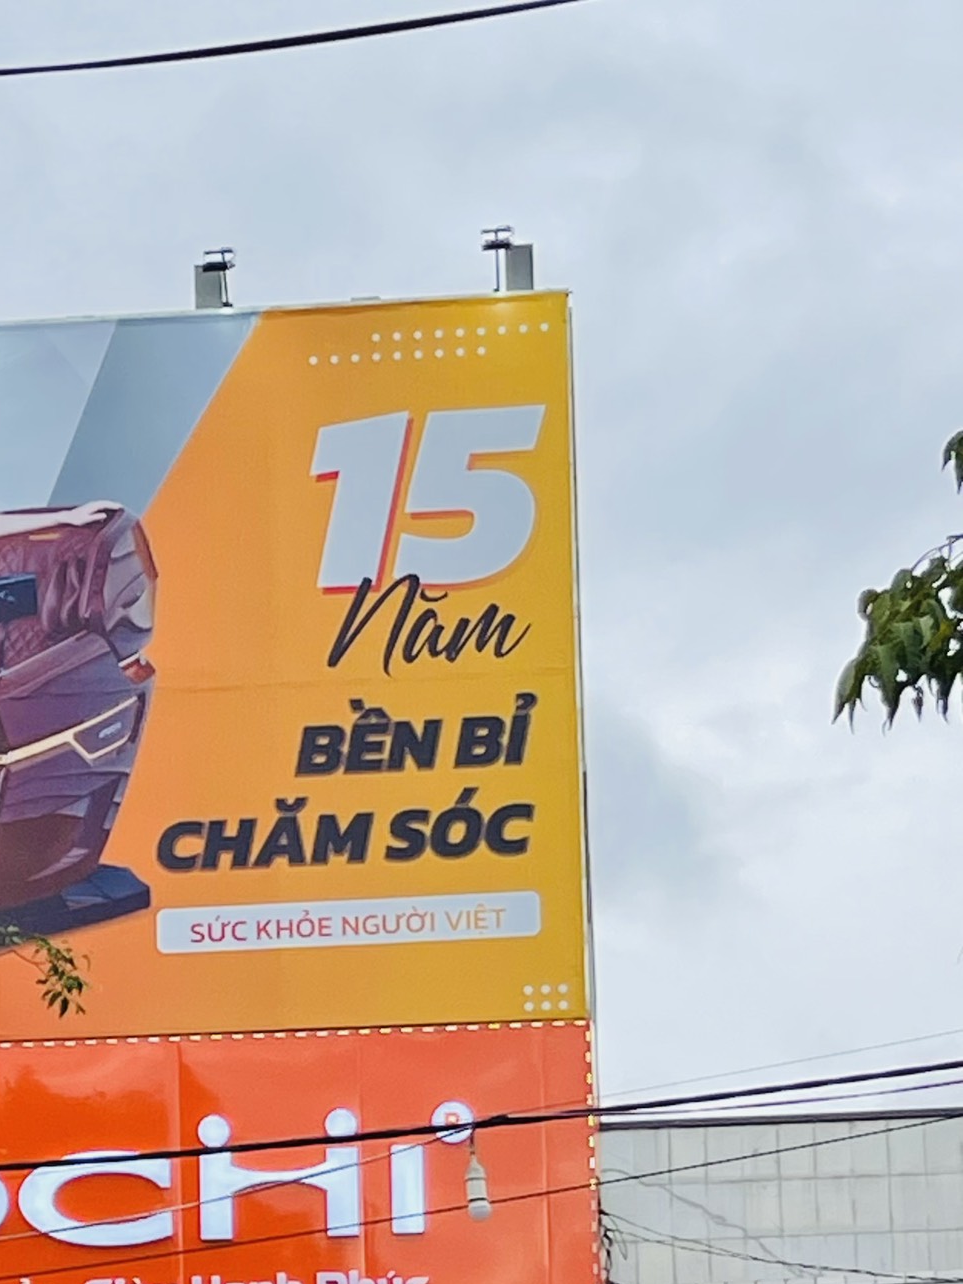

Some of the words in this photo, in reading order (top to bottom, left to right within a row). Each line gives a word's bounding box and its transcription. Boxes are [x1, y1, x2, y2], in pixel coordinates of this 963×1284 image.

[309, 404, 546, 593] 15
[327, 573, 532, 677] Năm
[295, 698, 441, 778] BỀN
[454, 693, 538, 767] BỈ
[157, 796, 374, 871] CHĂM
[384, 787, 534, 860] SÓC
[190, 915, 248, 943] SỨC
[256, 909, 333, 940] KHỎE
[341, 906, 436, 936] NGƯỜI
[444, 903, 507, 935] VIỆT
